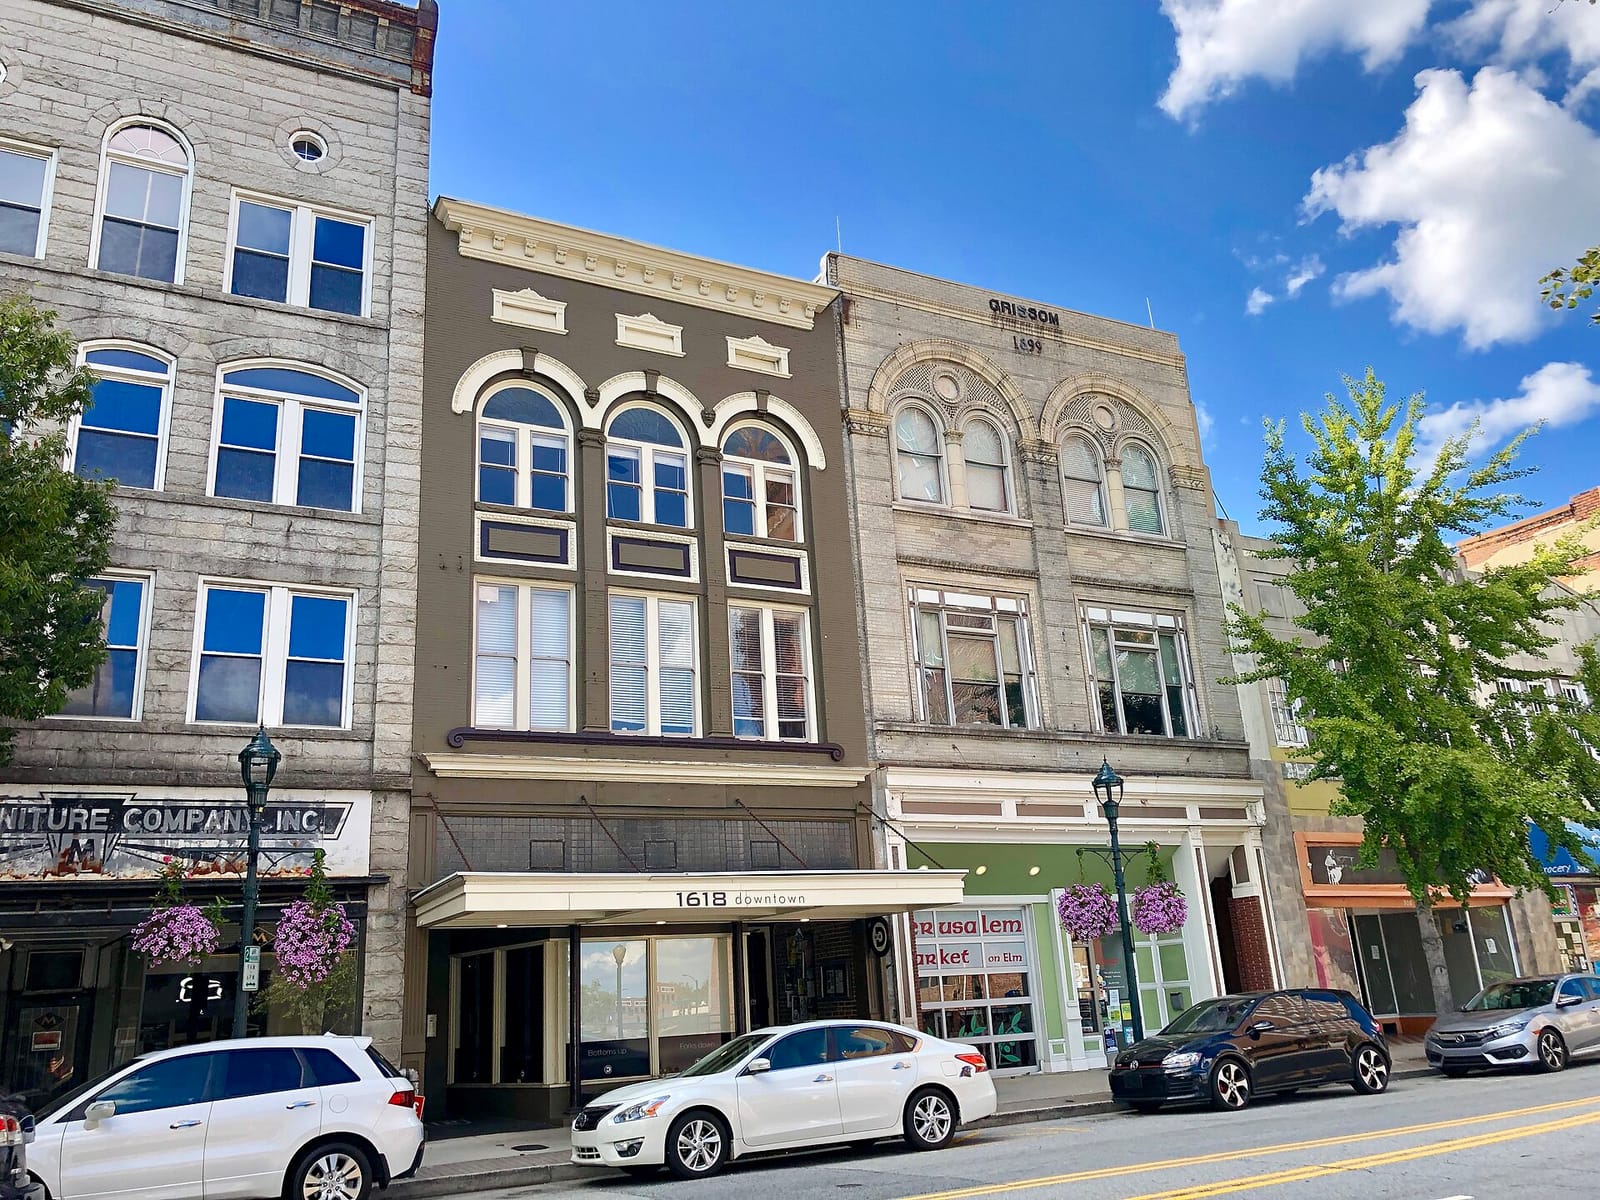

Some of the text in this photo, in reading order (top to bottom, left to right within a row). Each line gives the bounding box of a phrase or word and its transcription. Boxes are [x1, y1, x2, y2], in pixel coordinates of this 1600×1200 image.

[988, 298, 1060, 326] GRISSOM
[0, 806, 110, 833] NITURE
[676, 892, 805, 907] 1618 downtown
[988, 955, 1000, 963] on
[1003, 952, 1022, 963] Elm
[587, 1047, 617, 1058] Bottoms
